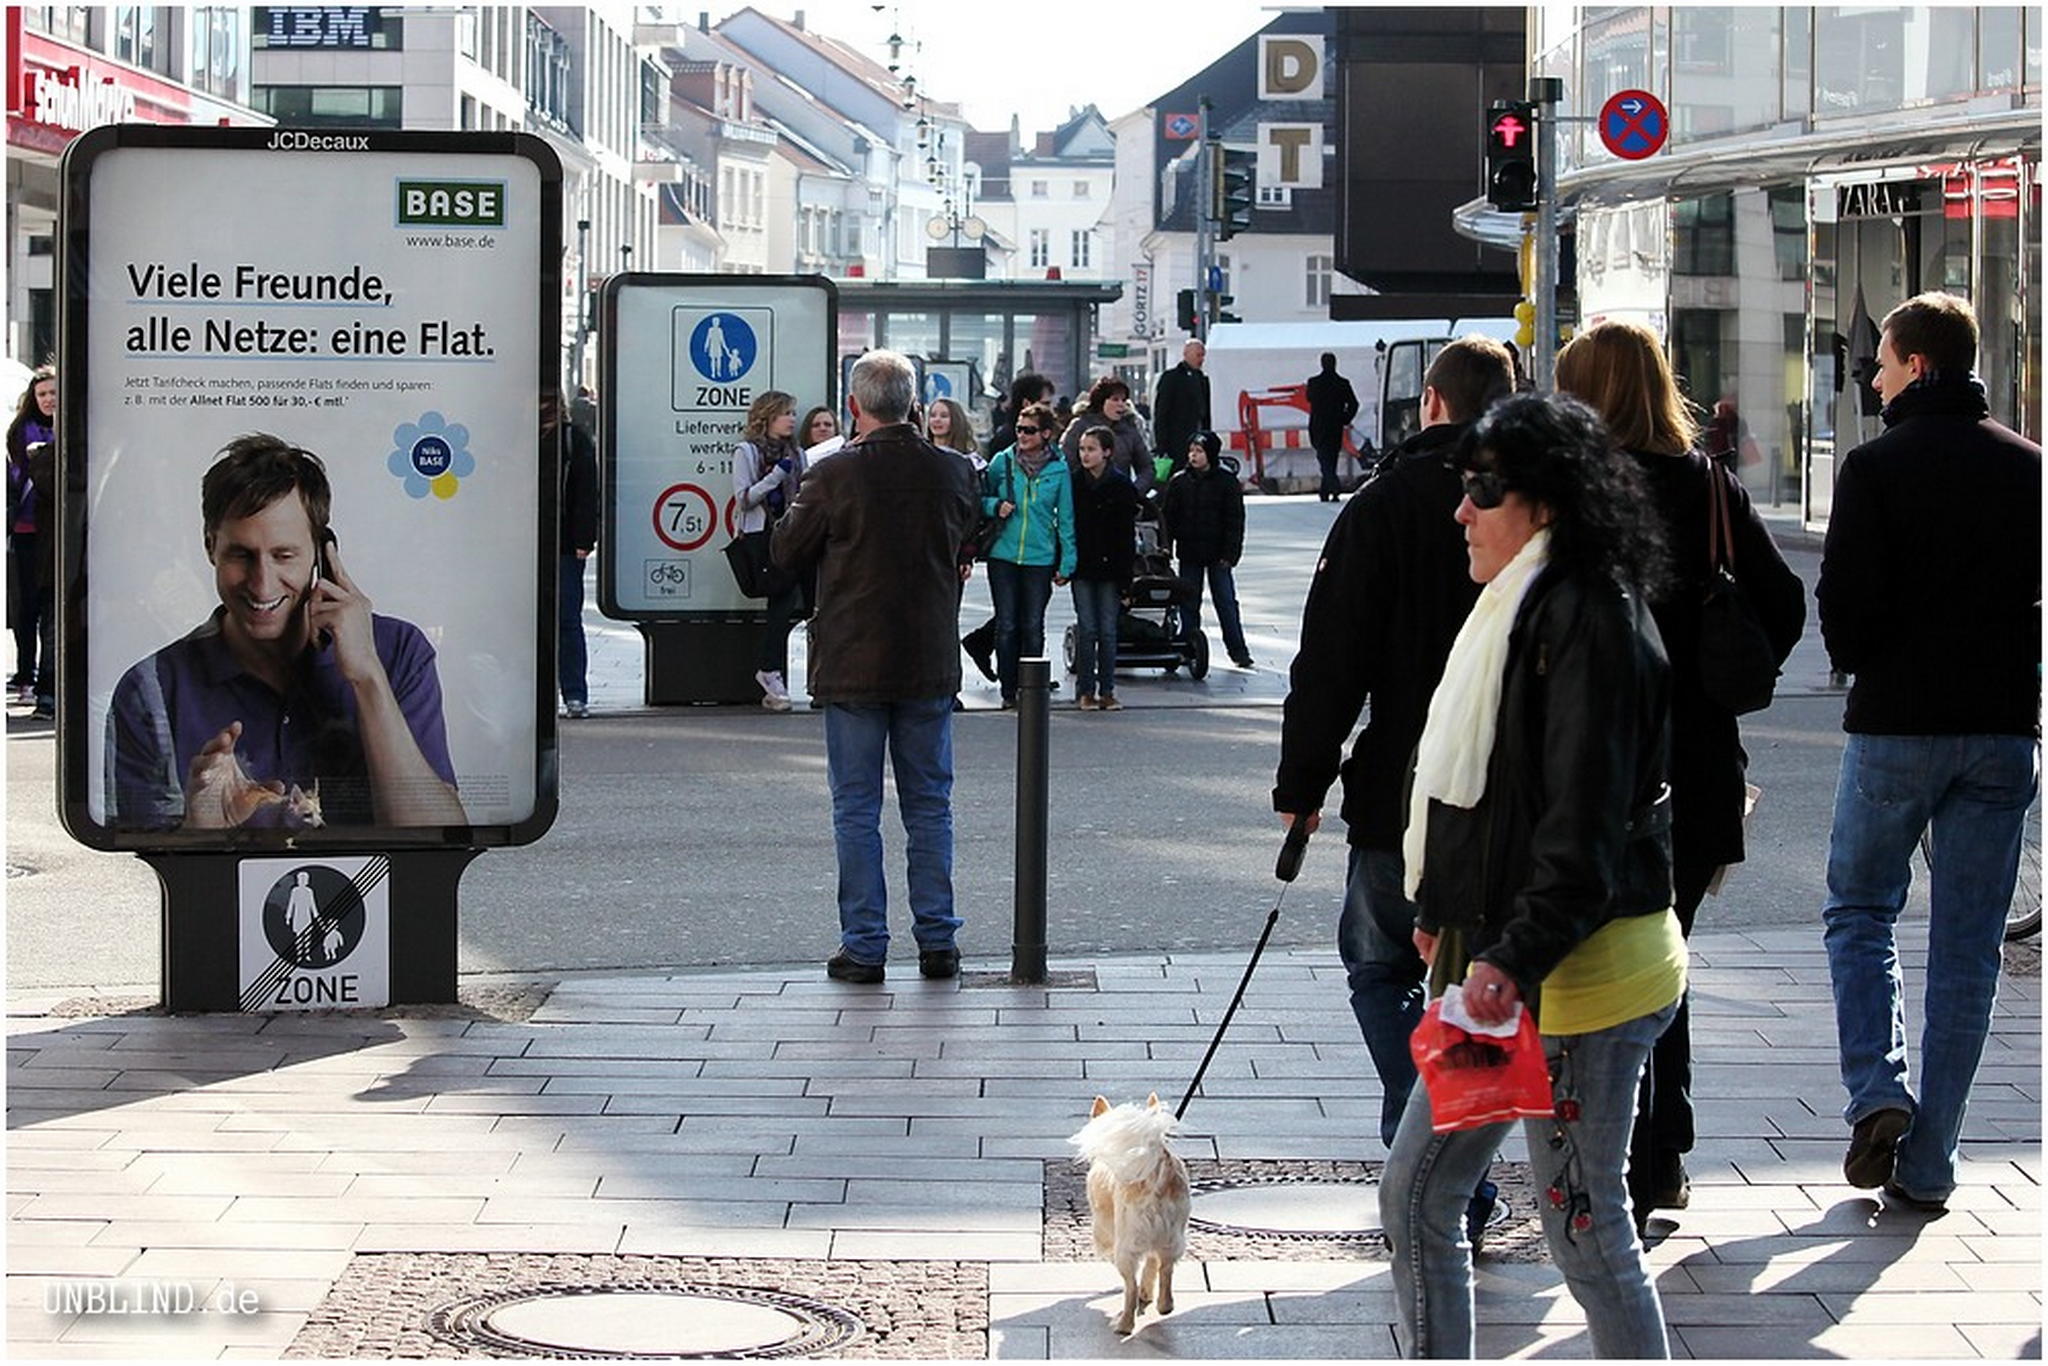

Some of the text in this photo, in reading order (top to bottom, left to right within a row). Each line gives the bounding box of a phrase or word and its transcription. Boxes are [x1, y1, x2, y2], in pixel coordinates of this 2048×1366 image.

[268, 8, 369, 45] IBM
[1266, 40, 1317, 93] D
[267, 132, 370, 150] JCDecaux
[1270, 128, 1311, 182] T
[406, 190, 496, 218] BASE
[1843, 182, 1893, 217] ZARA
[406, 235, 495, 248] www.base.de
[127, 263, 393, 306] Viele Freunde,
[126, 316, 494, 356] alle Netze: eine Flat.
[124, 377, 434, 392] Jetzt Tarifcheck machen, passende Flats finden und sparen:
[695, 387, 751, 406] ZONE
[149, 395, 167, 405] mit
[169, 395, 187, 405] der
[190, 396, 223, 406] Allnet
[226, 396, 246, 406] Flat
[249, 396, 270, 406] 500
[273, 395, 289, 406] für
[420, 456, 443, 466] BASE
[696, 461, 705, 474] 6
[720, 461, 733, 474] 11
[274, 975, 359, 1004] ZONE
